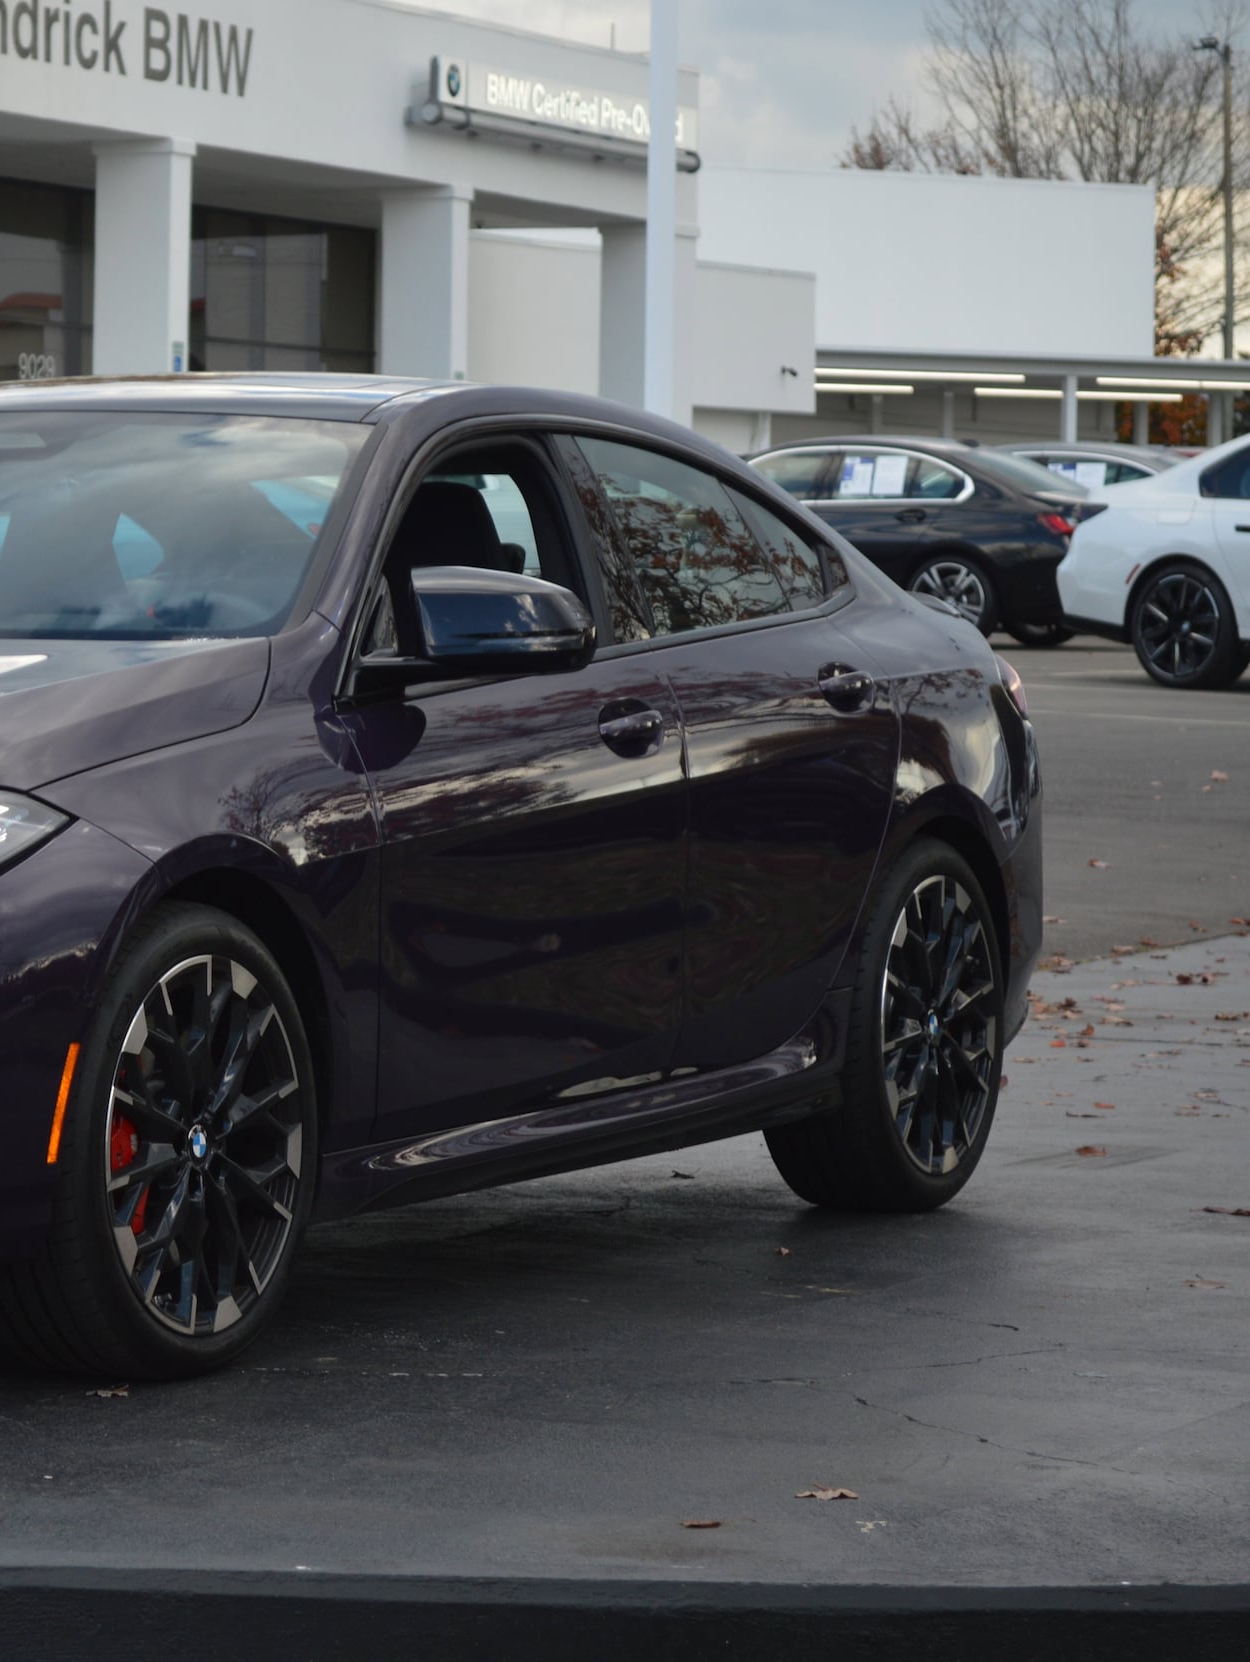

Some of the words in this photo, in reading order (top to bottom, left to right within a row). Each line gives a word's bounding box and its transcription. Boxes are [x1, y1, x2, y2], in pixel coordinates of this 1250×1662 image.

[144, 6, 253, 98] BMW
[487, 72, 531, 112] BMW
[532, 83, 599, 126] Certified
[601, 97, 684, 143] Pre-Od
[19, 352, 54, 379] 9029
